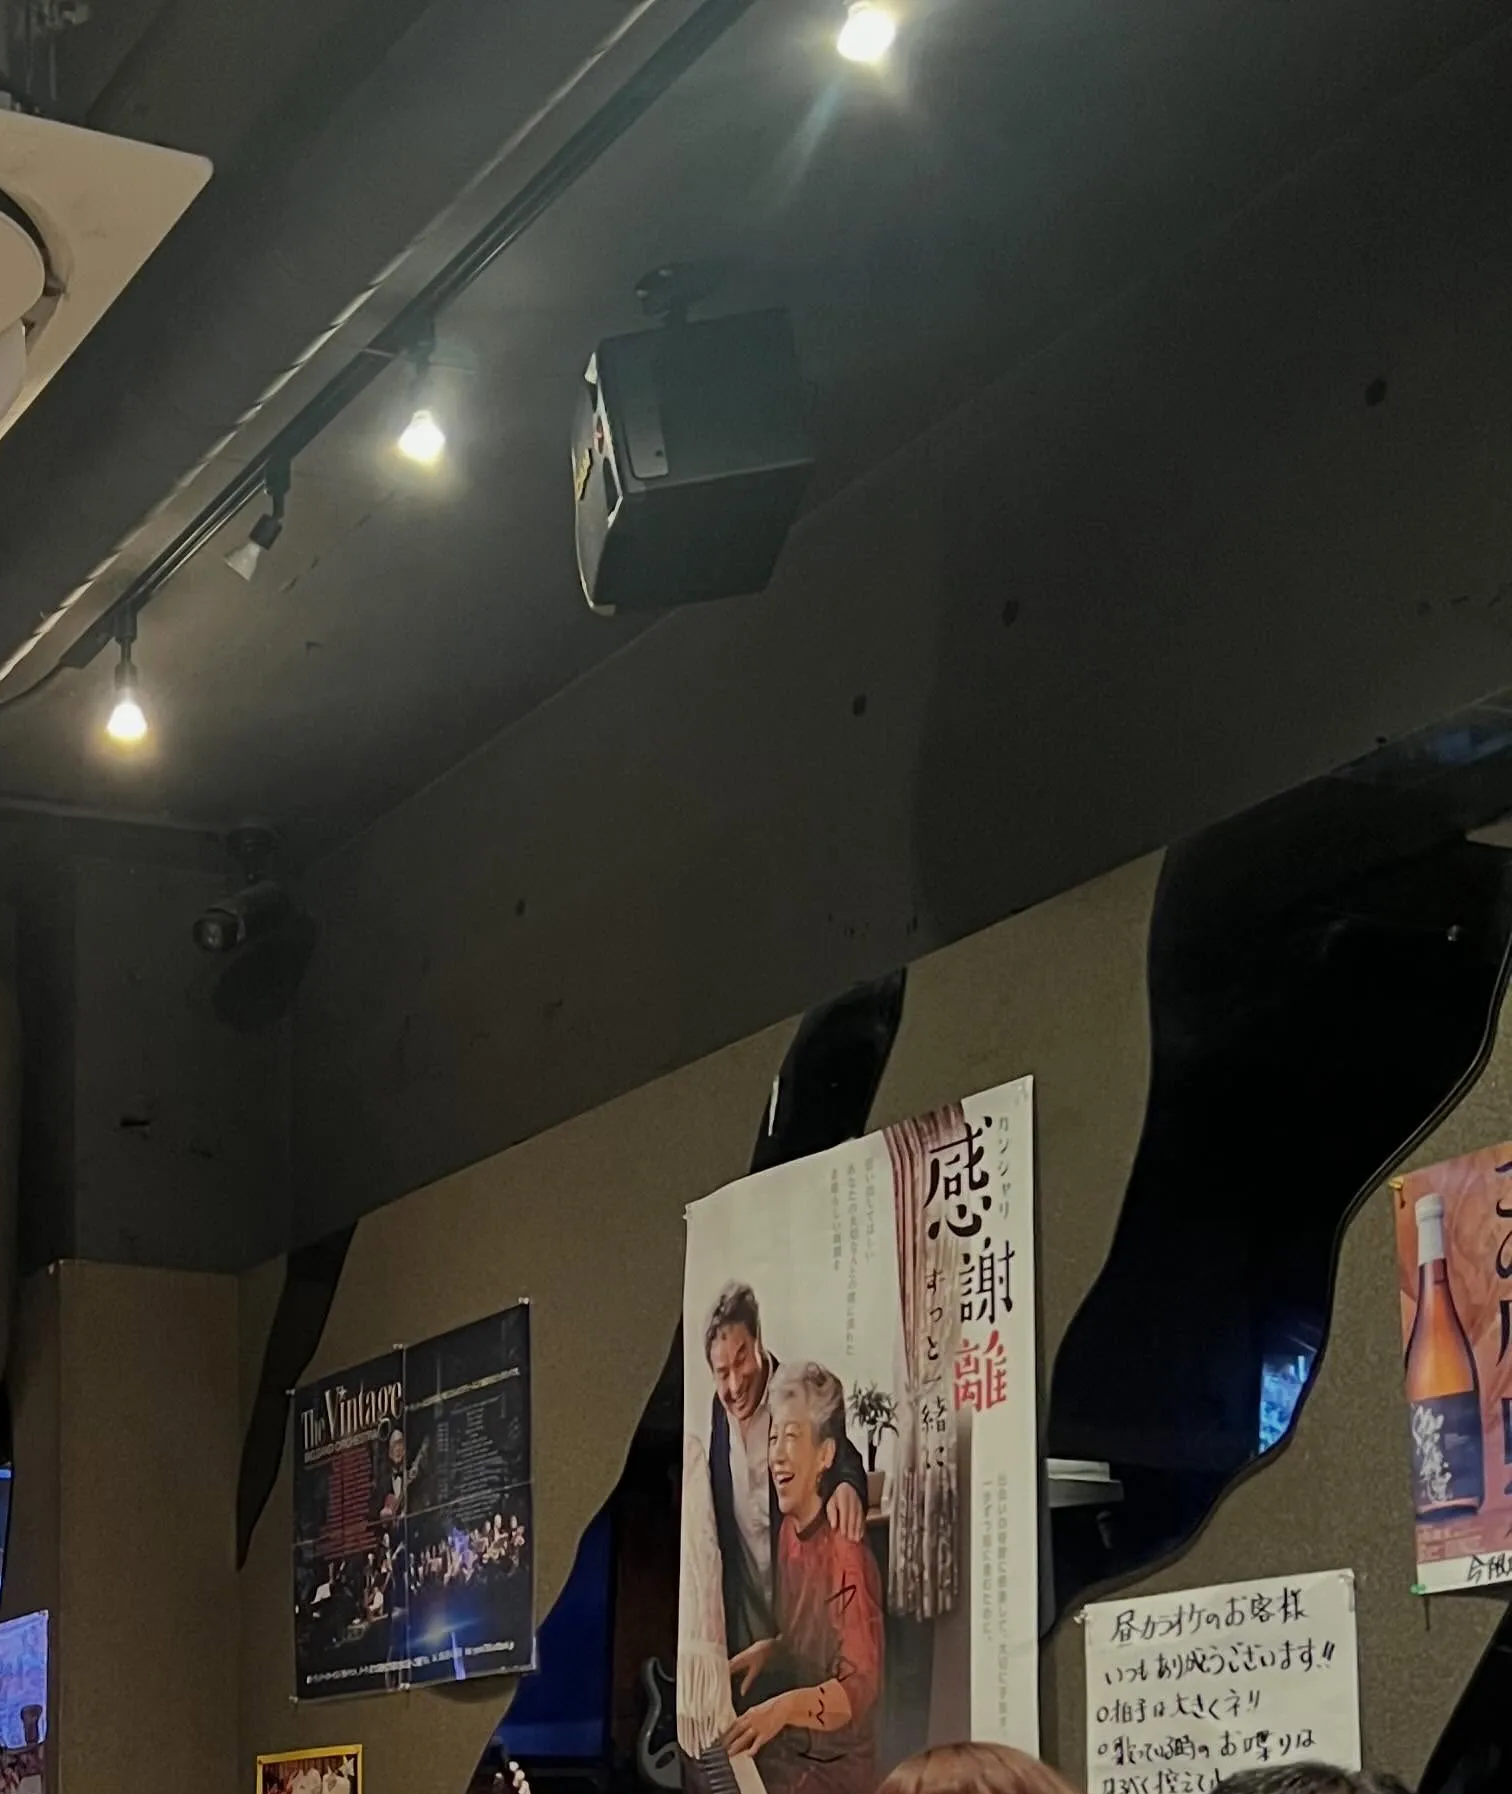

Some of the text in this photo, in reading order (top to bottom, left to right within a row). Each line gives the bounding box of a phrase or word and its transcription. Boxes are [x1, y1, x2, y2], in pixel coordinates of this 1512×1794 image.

[924, 1116, 1015, 1413] 感謝離
[301, 1409, 326, 1450] The
[324, 1381, 403, 1441] Vintage
[921, 1266, 948, 1469] ずっと一緒に
